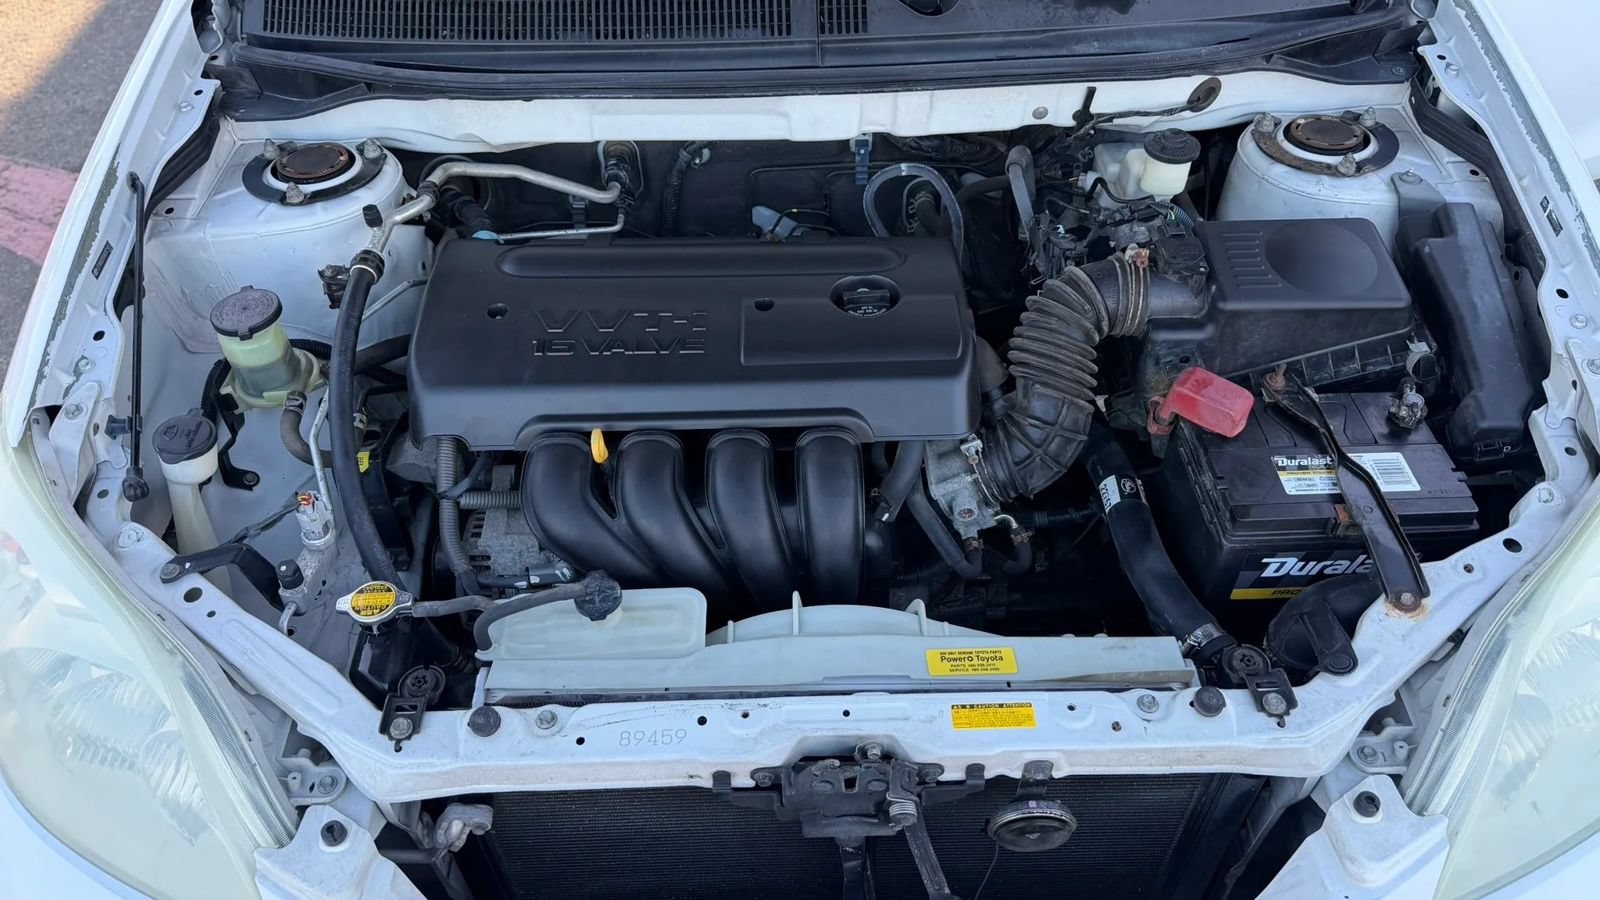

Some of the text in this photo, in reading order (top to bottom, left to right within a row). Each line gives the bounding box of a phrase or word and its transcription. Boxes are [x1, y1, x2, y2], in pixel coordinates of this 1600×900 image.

[531, 336, 706, 357] 16 VALVE
[1273, 455, 1333, 467] Duralast
[1260, 554, 1374, 578] Durala
[1271, 589, 1302, 597] PRO
[940, 654, 1004, 663] Power Toyota
[619, 728, 688, 747] 89459
